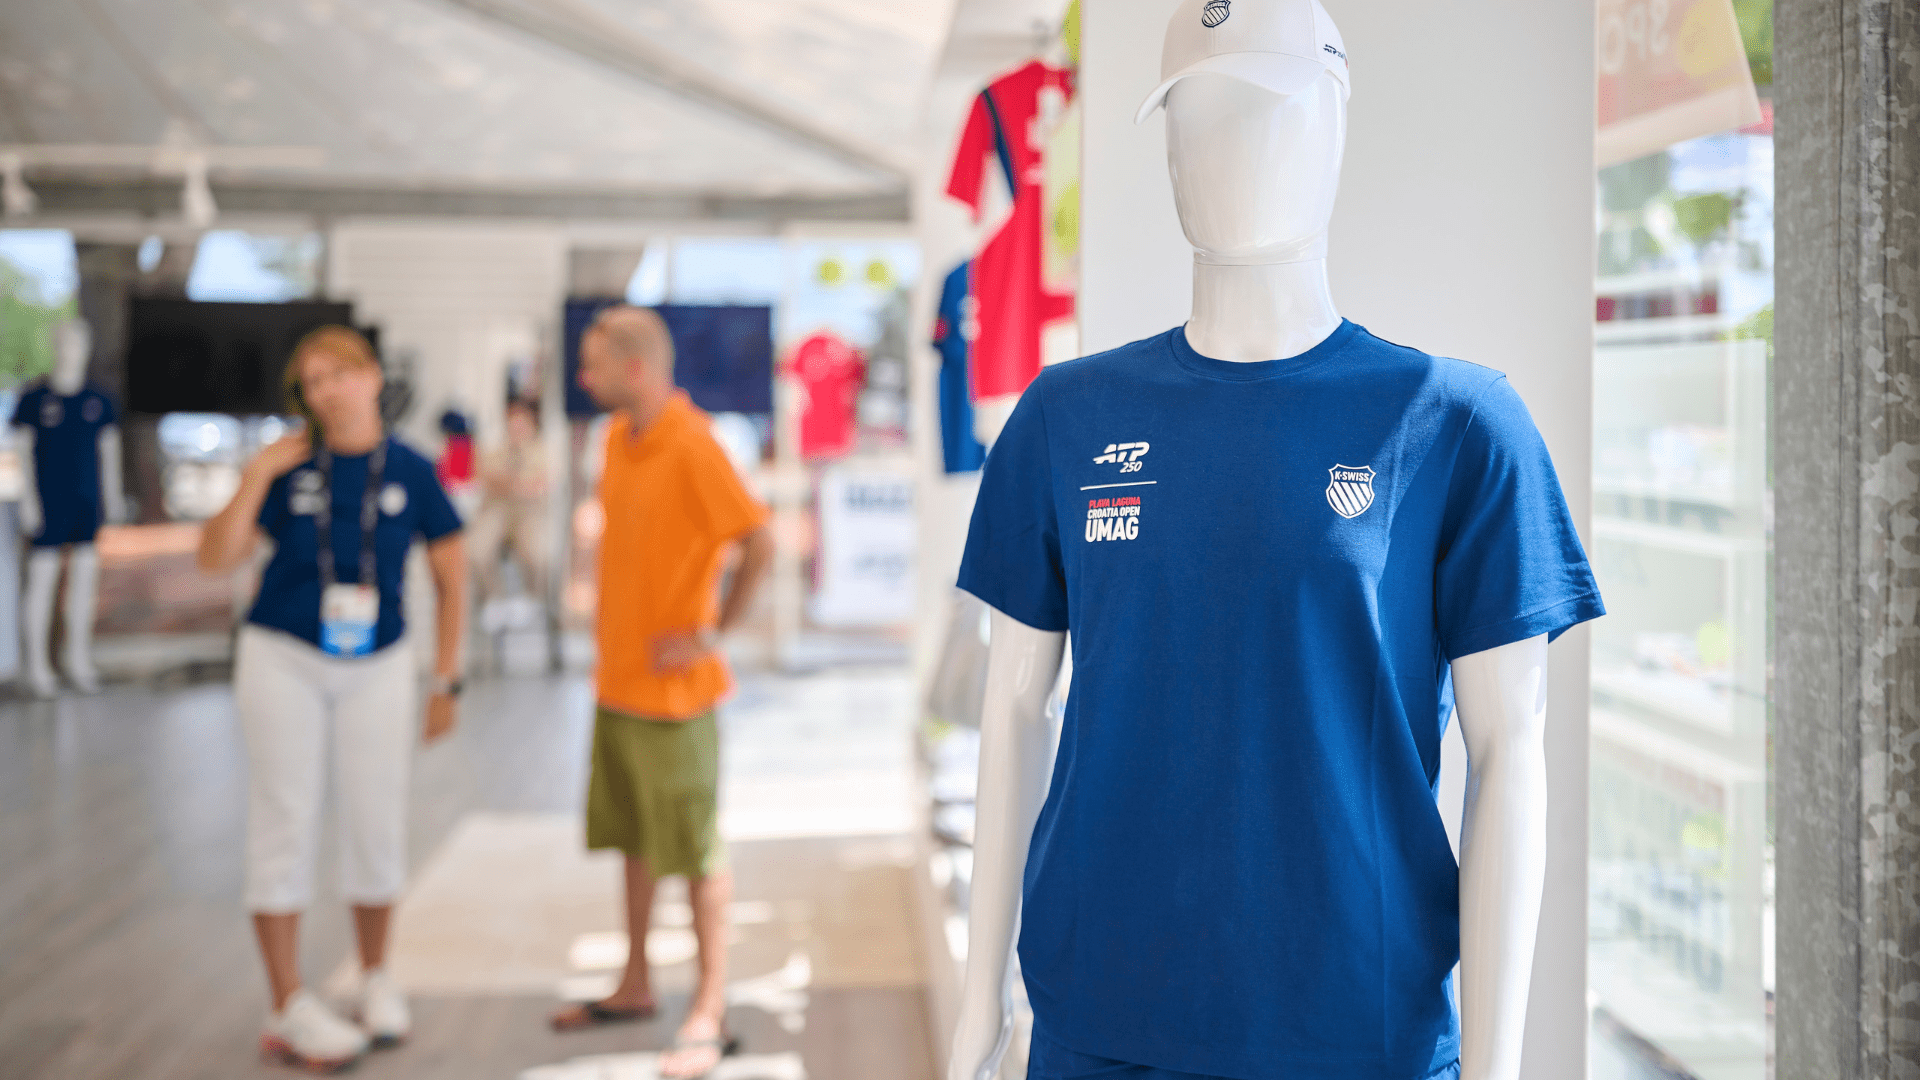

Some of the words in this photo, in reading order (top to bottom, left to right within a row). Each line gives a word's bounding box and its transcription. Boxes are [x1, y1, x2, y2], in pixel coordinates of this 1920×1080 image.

[1093, 441, 1150, 464] ATP
[1120, 461, 1143, 473] 250
[1089, 499, 1110, 509] PLAVA
[1112, 496, 1141, 507] LAGUNA
[1087, 507, 1119, 519] CROATIA
[1119, 506, 1140, 516] OPEN
[1085, 517, 1139, 542] UMAG
